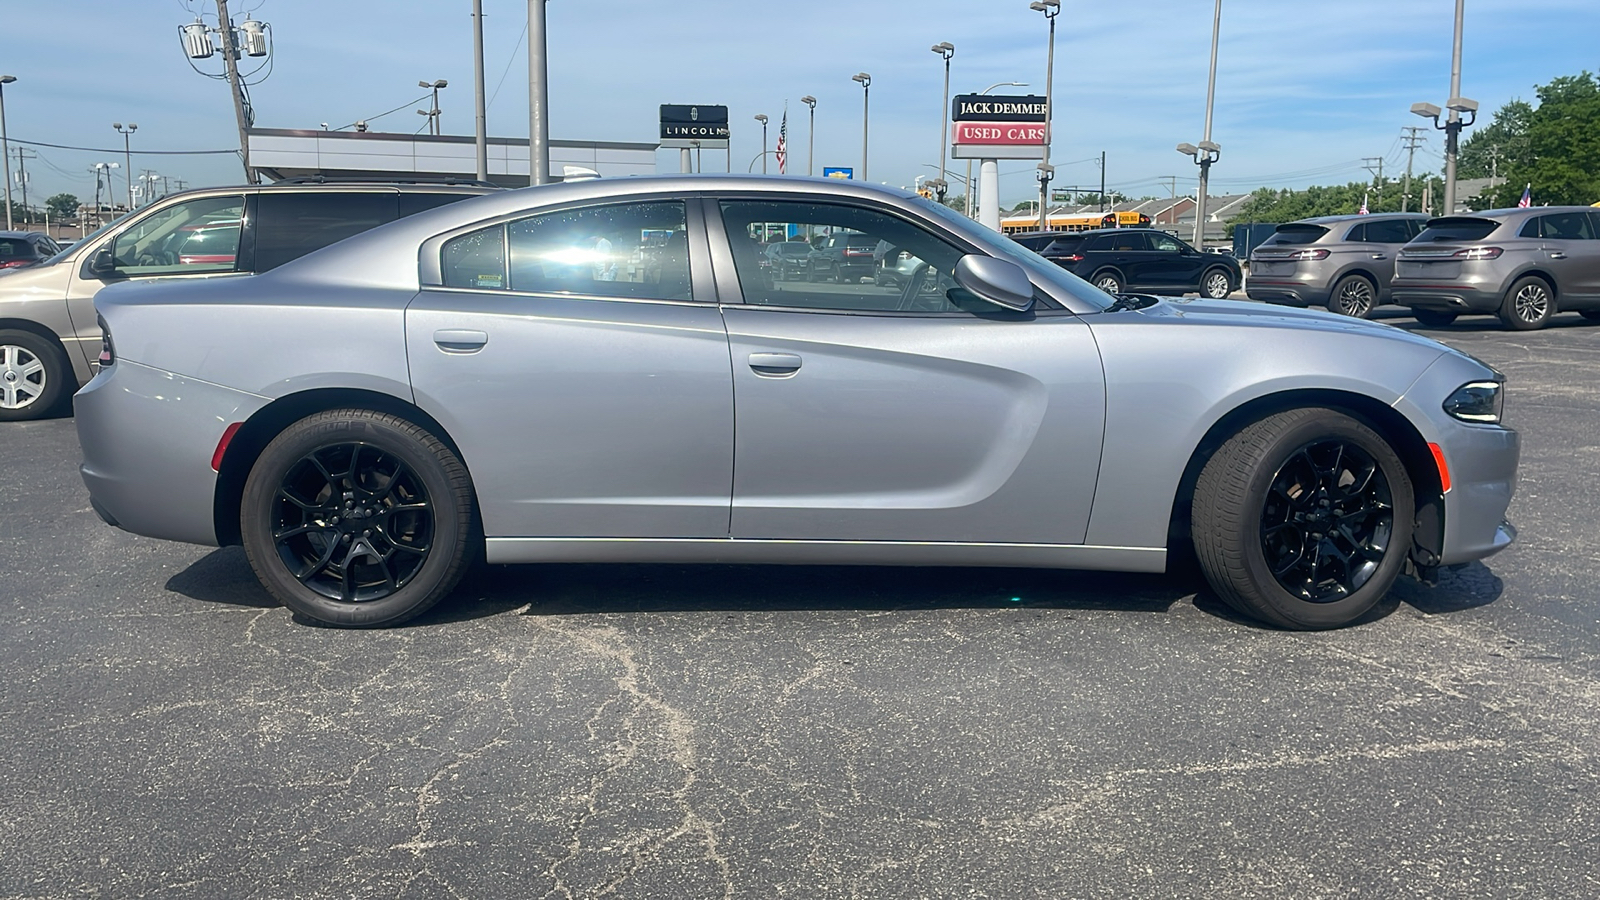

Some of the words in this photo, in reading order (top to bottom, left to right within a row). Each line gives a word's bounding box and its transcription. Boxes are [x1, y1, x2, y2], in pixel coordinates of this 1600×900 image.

[960, 102, 991, 115] JACK
[963, 127, 1002, 139] USED
[1007, 128, 1045, 140] CARS
